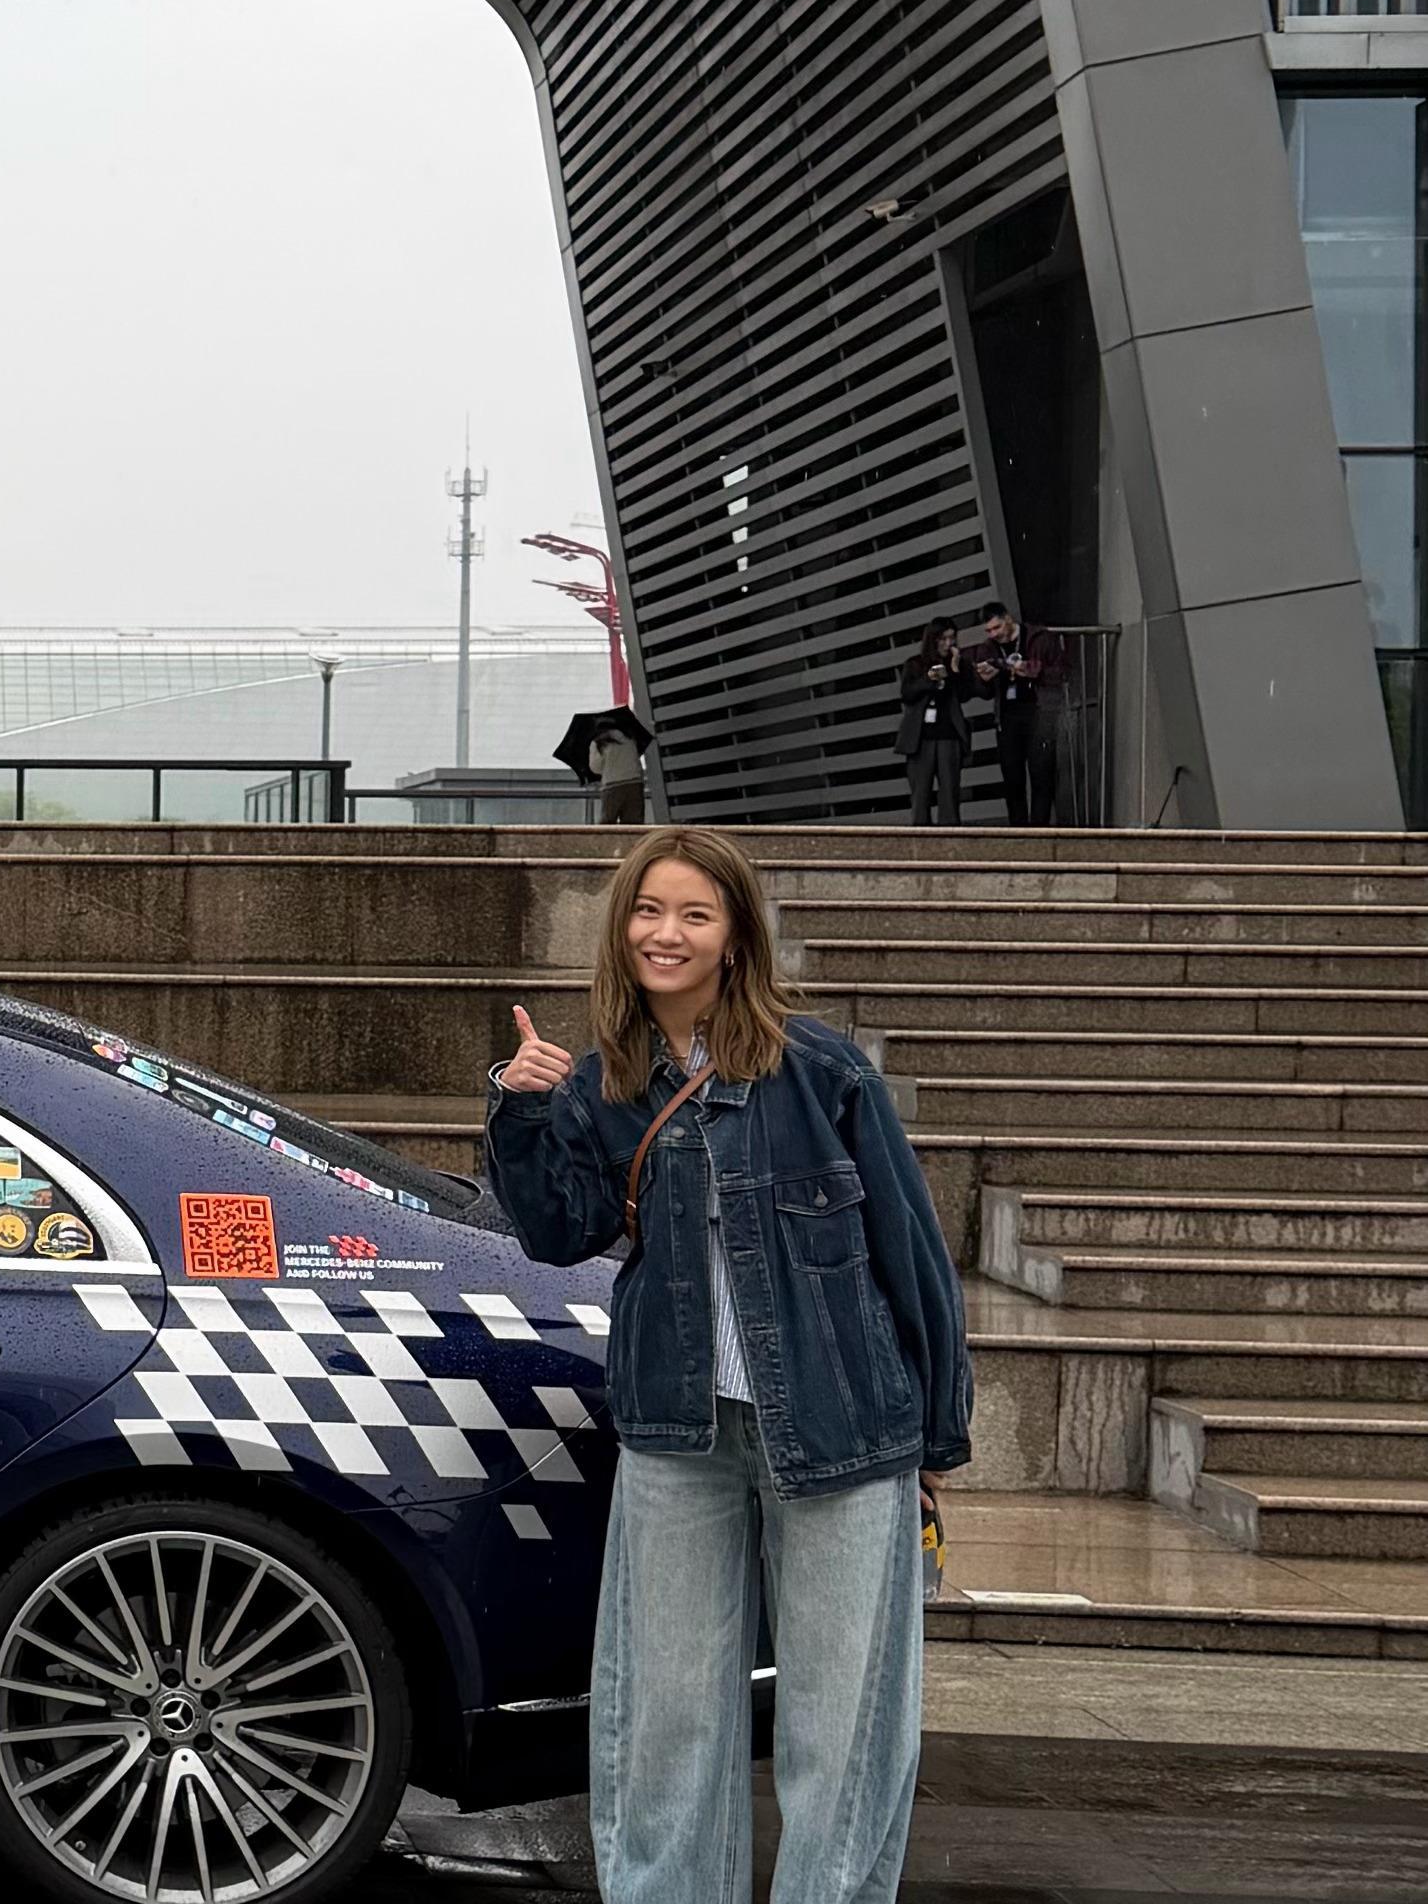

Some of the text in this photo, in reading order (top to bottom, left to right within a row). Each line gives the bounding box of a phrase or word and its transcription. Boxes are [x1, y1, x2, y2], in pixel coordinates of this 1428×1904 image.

[284, 1245, 330, 1255] JOIN THE
[376, 1259, 445, 1271] COMMUNITY
[286, 1269, 375, 1280] AND FOLLOW US
